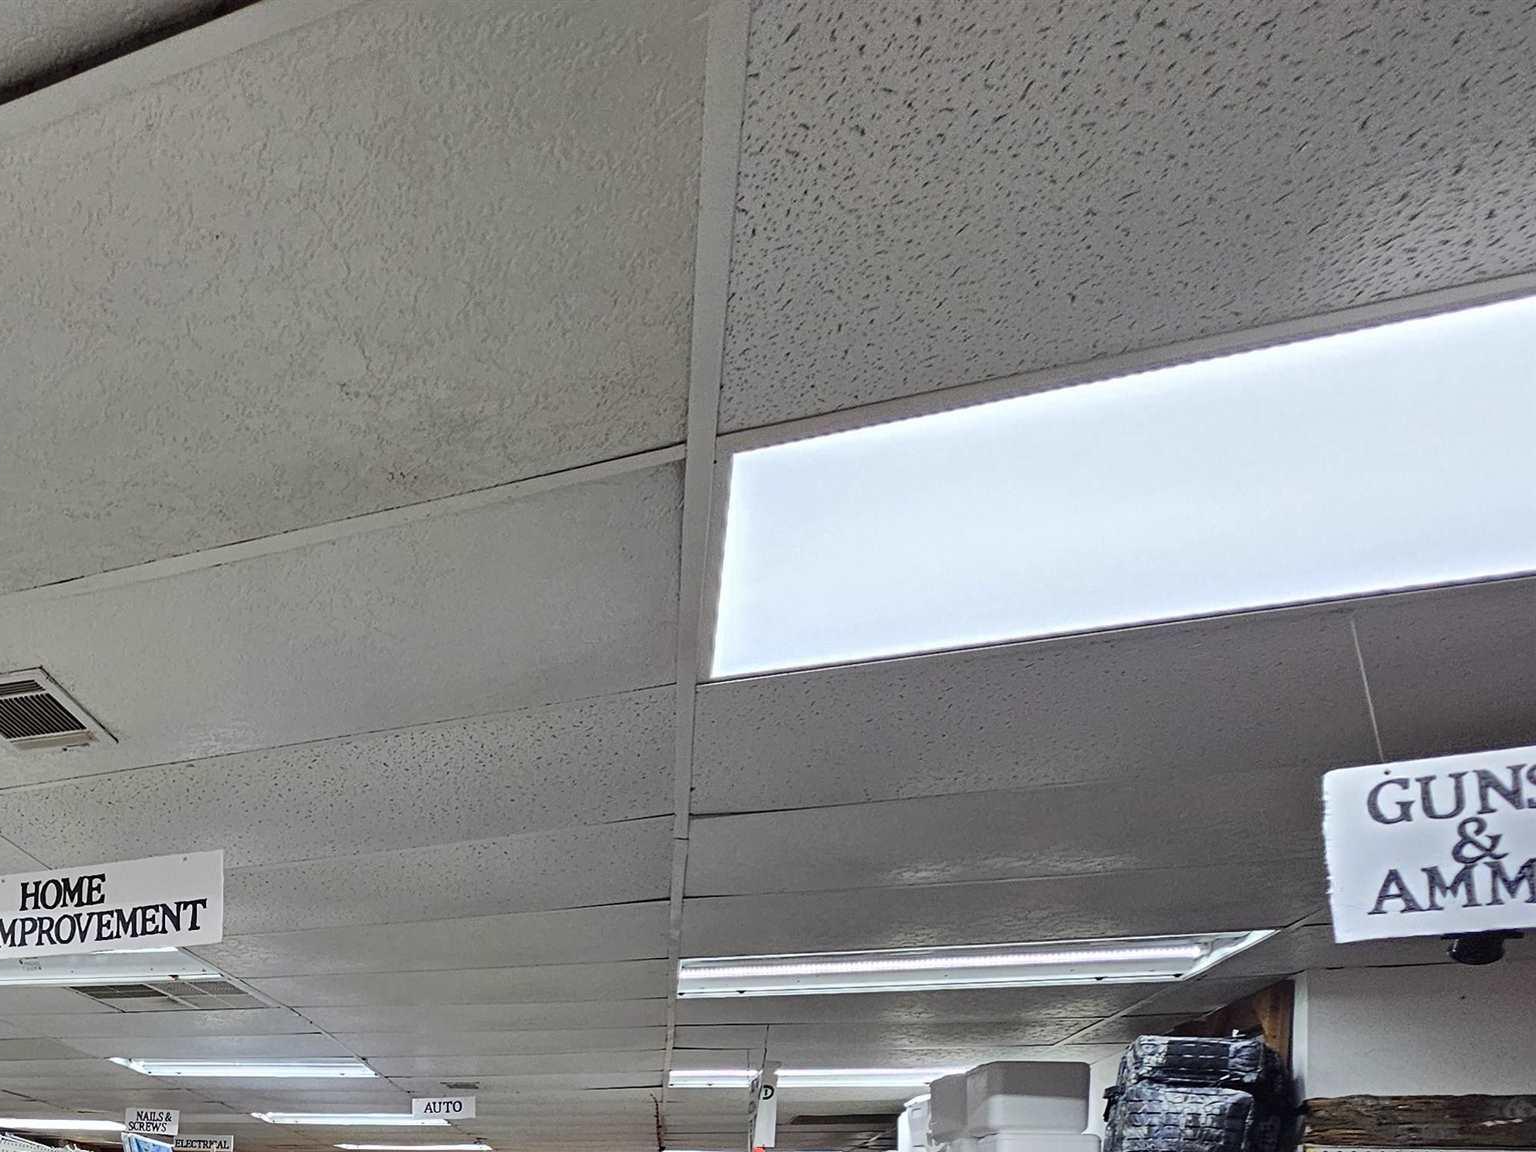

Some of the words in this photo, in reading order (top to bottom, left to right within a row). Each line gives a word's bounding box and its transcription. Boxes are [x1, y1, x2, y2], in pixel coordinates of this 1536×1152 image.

[1451, 816, 1509, 865] &
[19, 873, 106, 912] HOME
[423, 1100, 463, 1114] AUTO
[136, 1110, 164, 1122] NAILS
[128, 1121, 168, 1133] SCREWS
